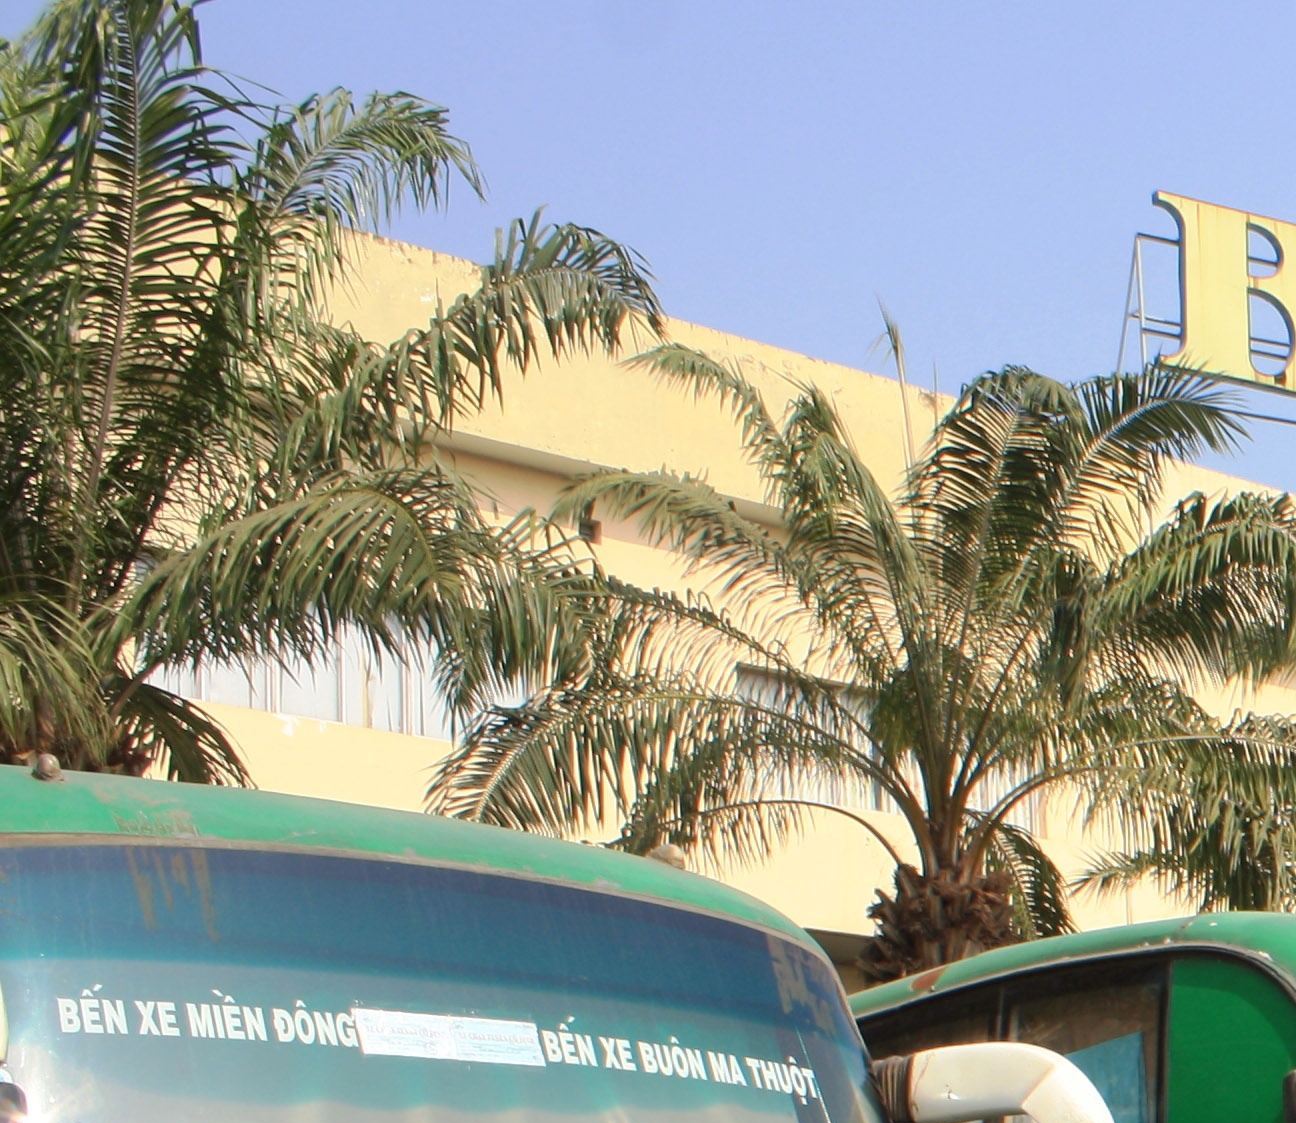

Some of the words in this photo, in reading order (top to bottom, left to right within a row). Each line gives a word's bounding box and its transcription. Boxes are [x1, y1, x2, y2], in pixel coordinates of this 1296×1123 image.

[57, 983, 128, 1035] BẾN
[134, 1000, 181, 1037] XE
[186, 988, 268, 1042] MIỀN
[273, 1000, 359, 1048] ĐÔNG
[541, 1016, 598, 1067] BẾN
[598, 1037, 637, 1071] XE
[637, 1036, 708, 1081] BUÔN
[708, 1051, 748, 1086] MA
[745, 1055, 819, 1105] THUỘT
